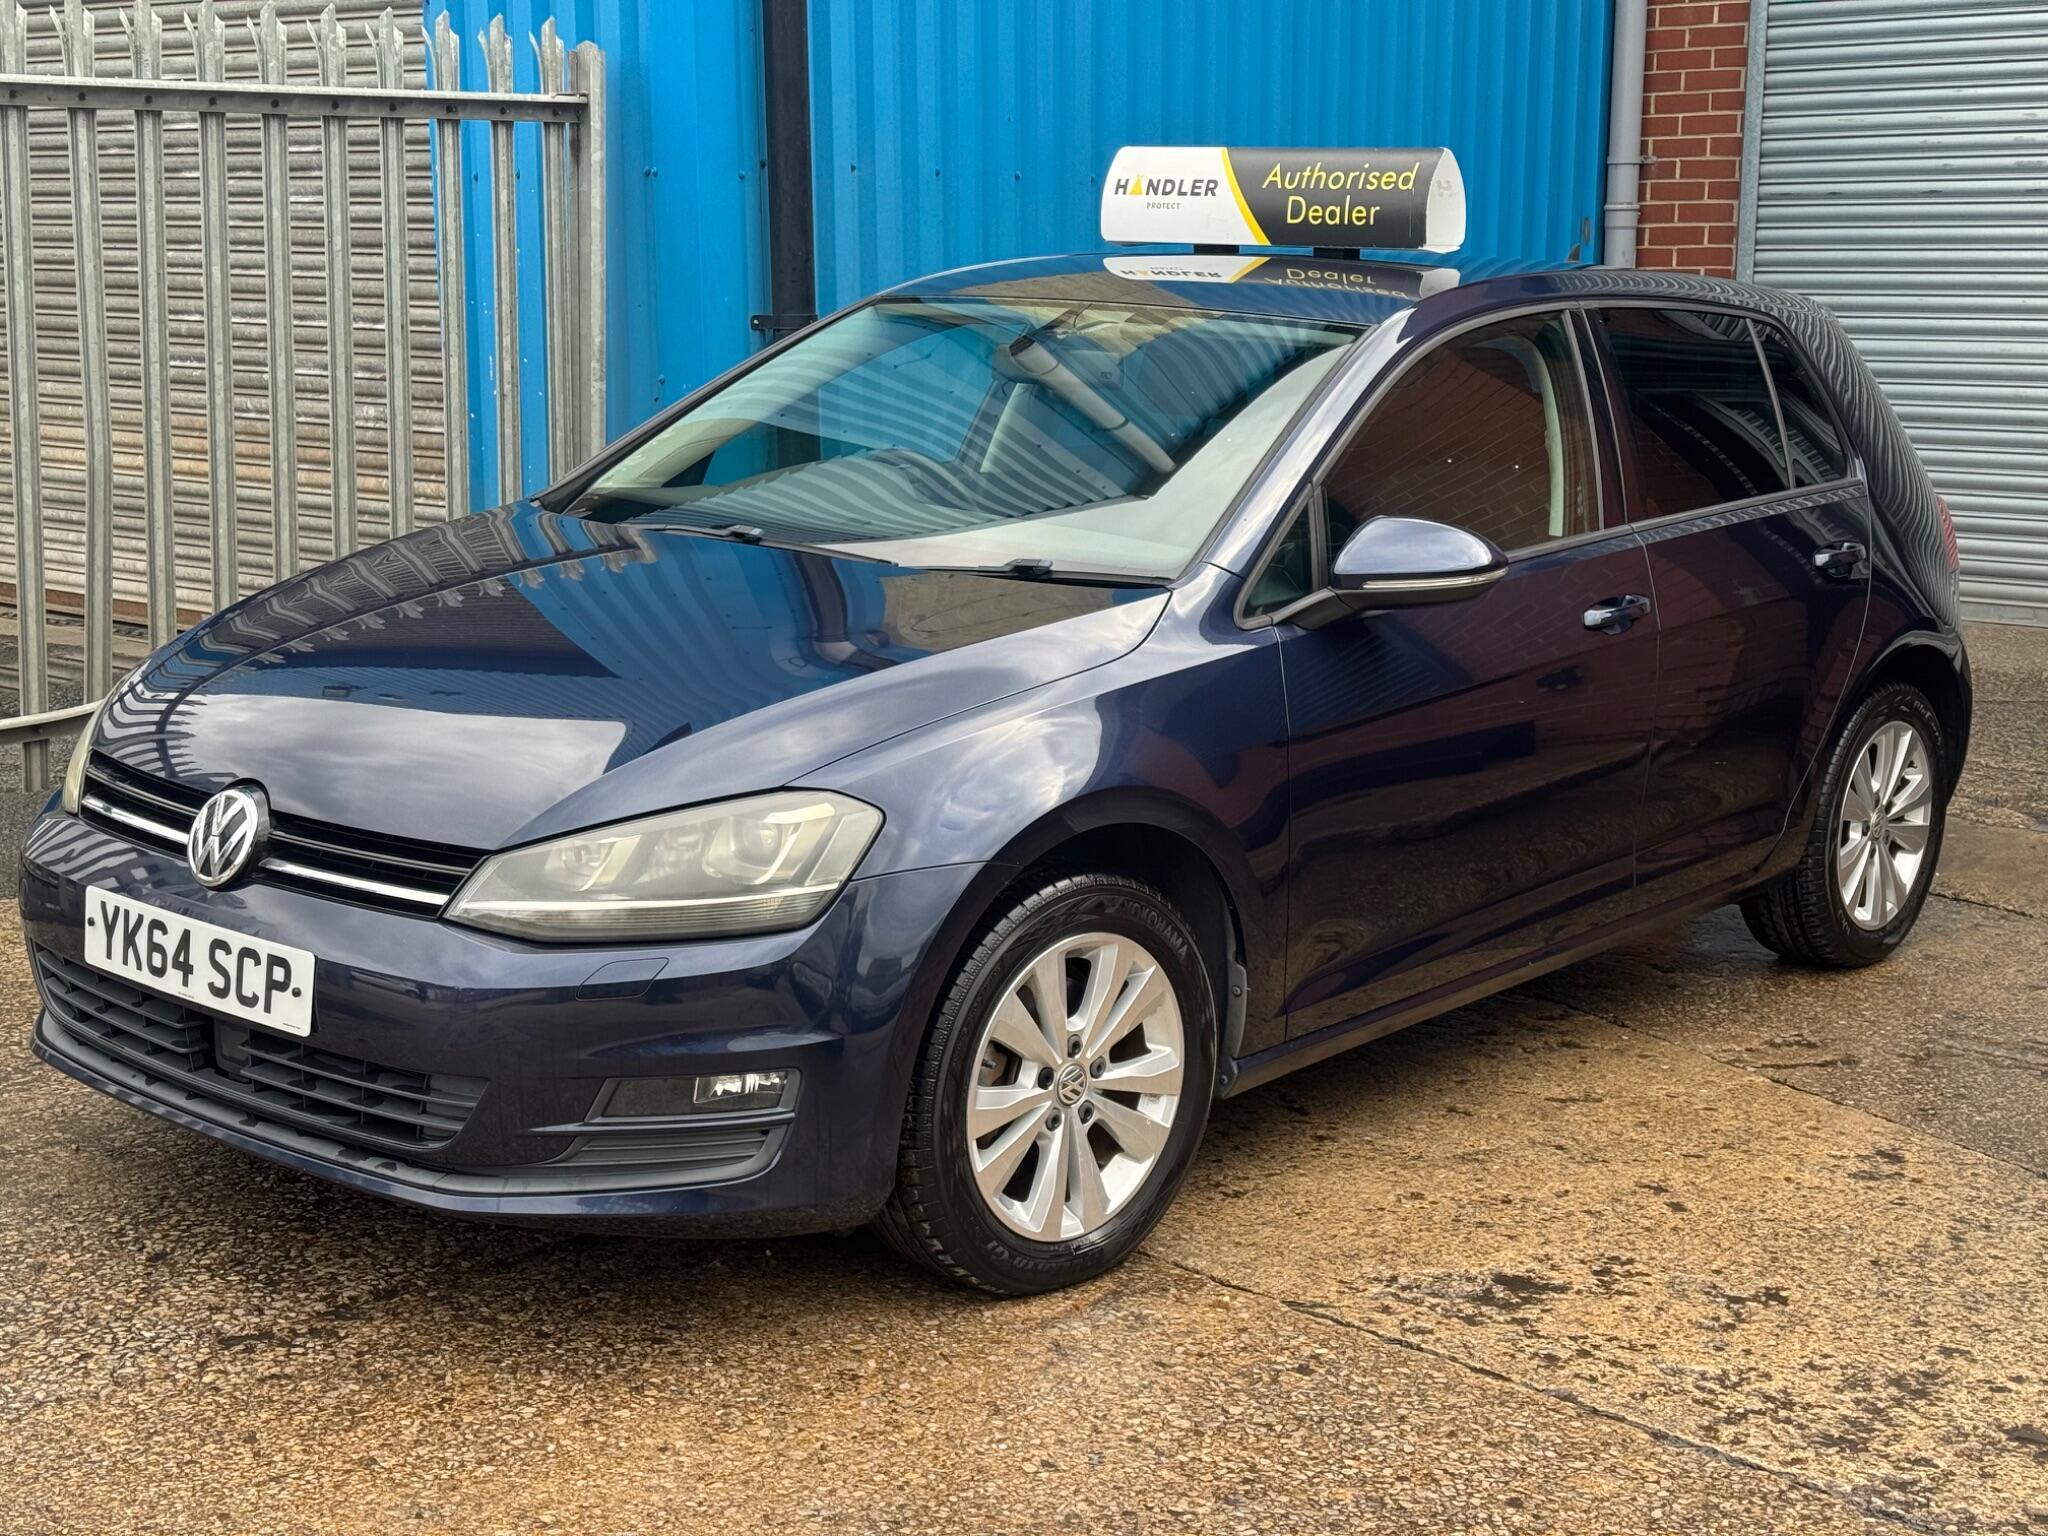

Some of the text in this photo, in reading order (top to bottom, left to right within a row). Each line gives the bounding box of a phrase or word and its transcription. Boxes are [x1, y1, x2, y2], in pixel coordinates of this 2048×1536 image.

[1114, 174, 1219, 196] HANDLER
[1262, 161, 1420, 190] Authorised
[1146, 202, 1181, 210] PROTECT
[1287, 195, 1380, 225] Dealer
[1122, 898, 1189, 960] YOKOHAMA
[100, 900, 292, 1014] YK64 SCP
